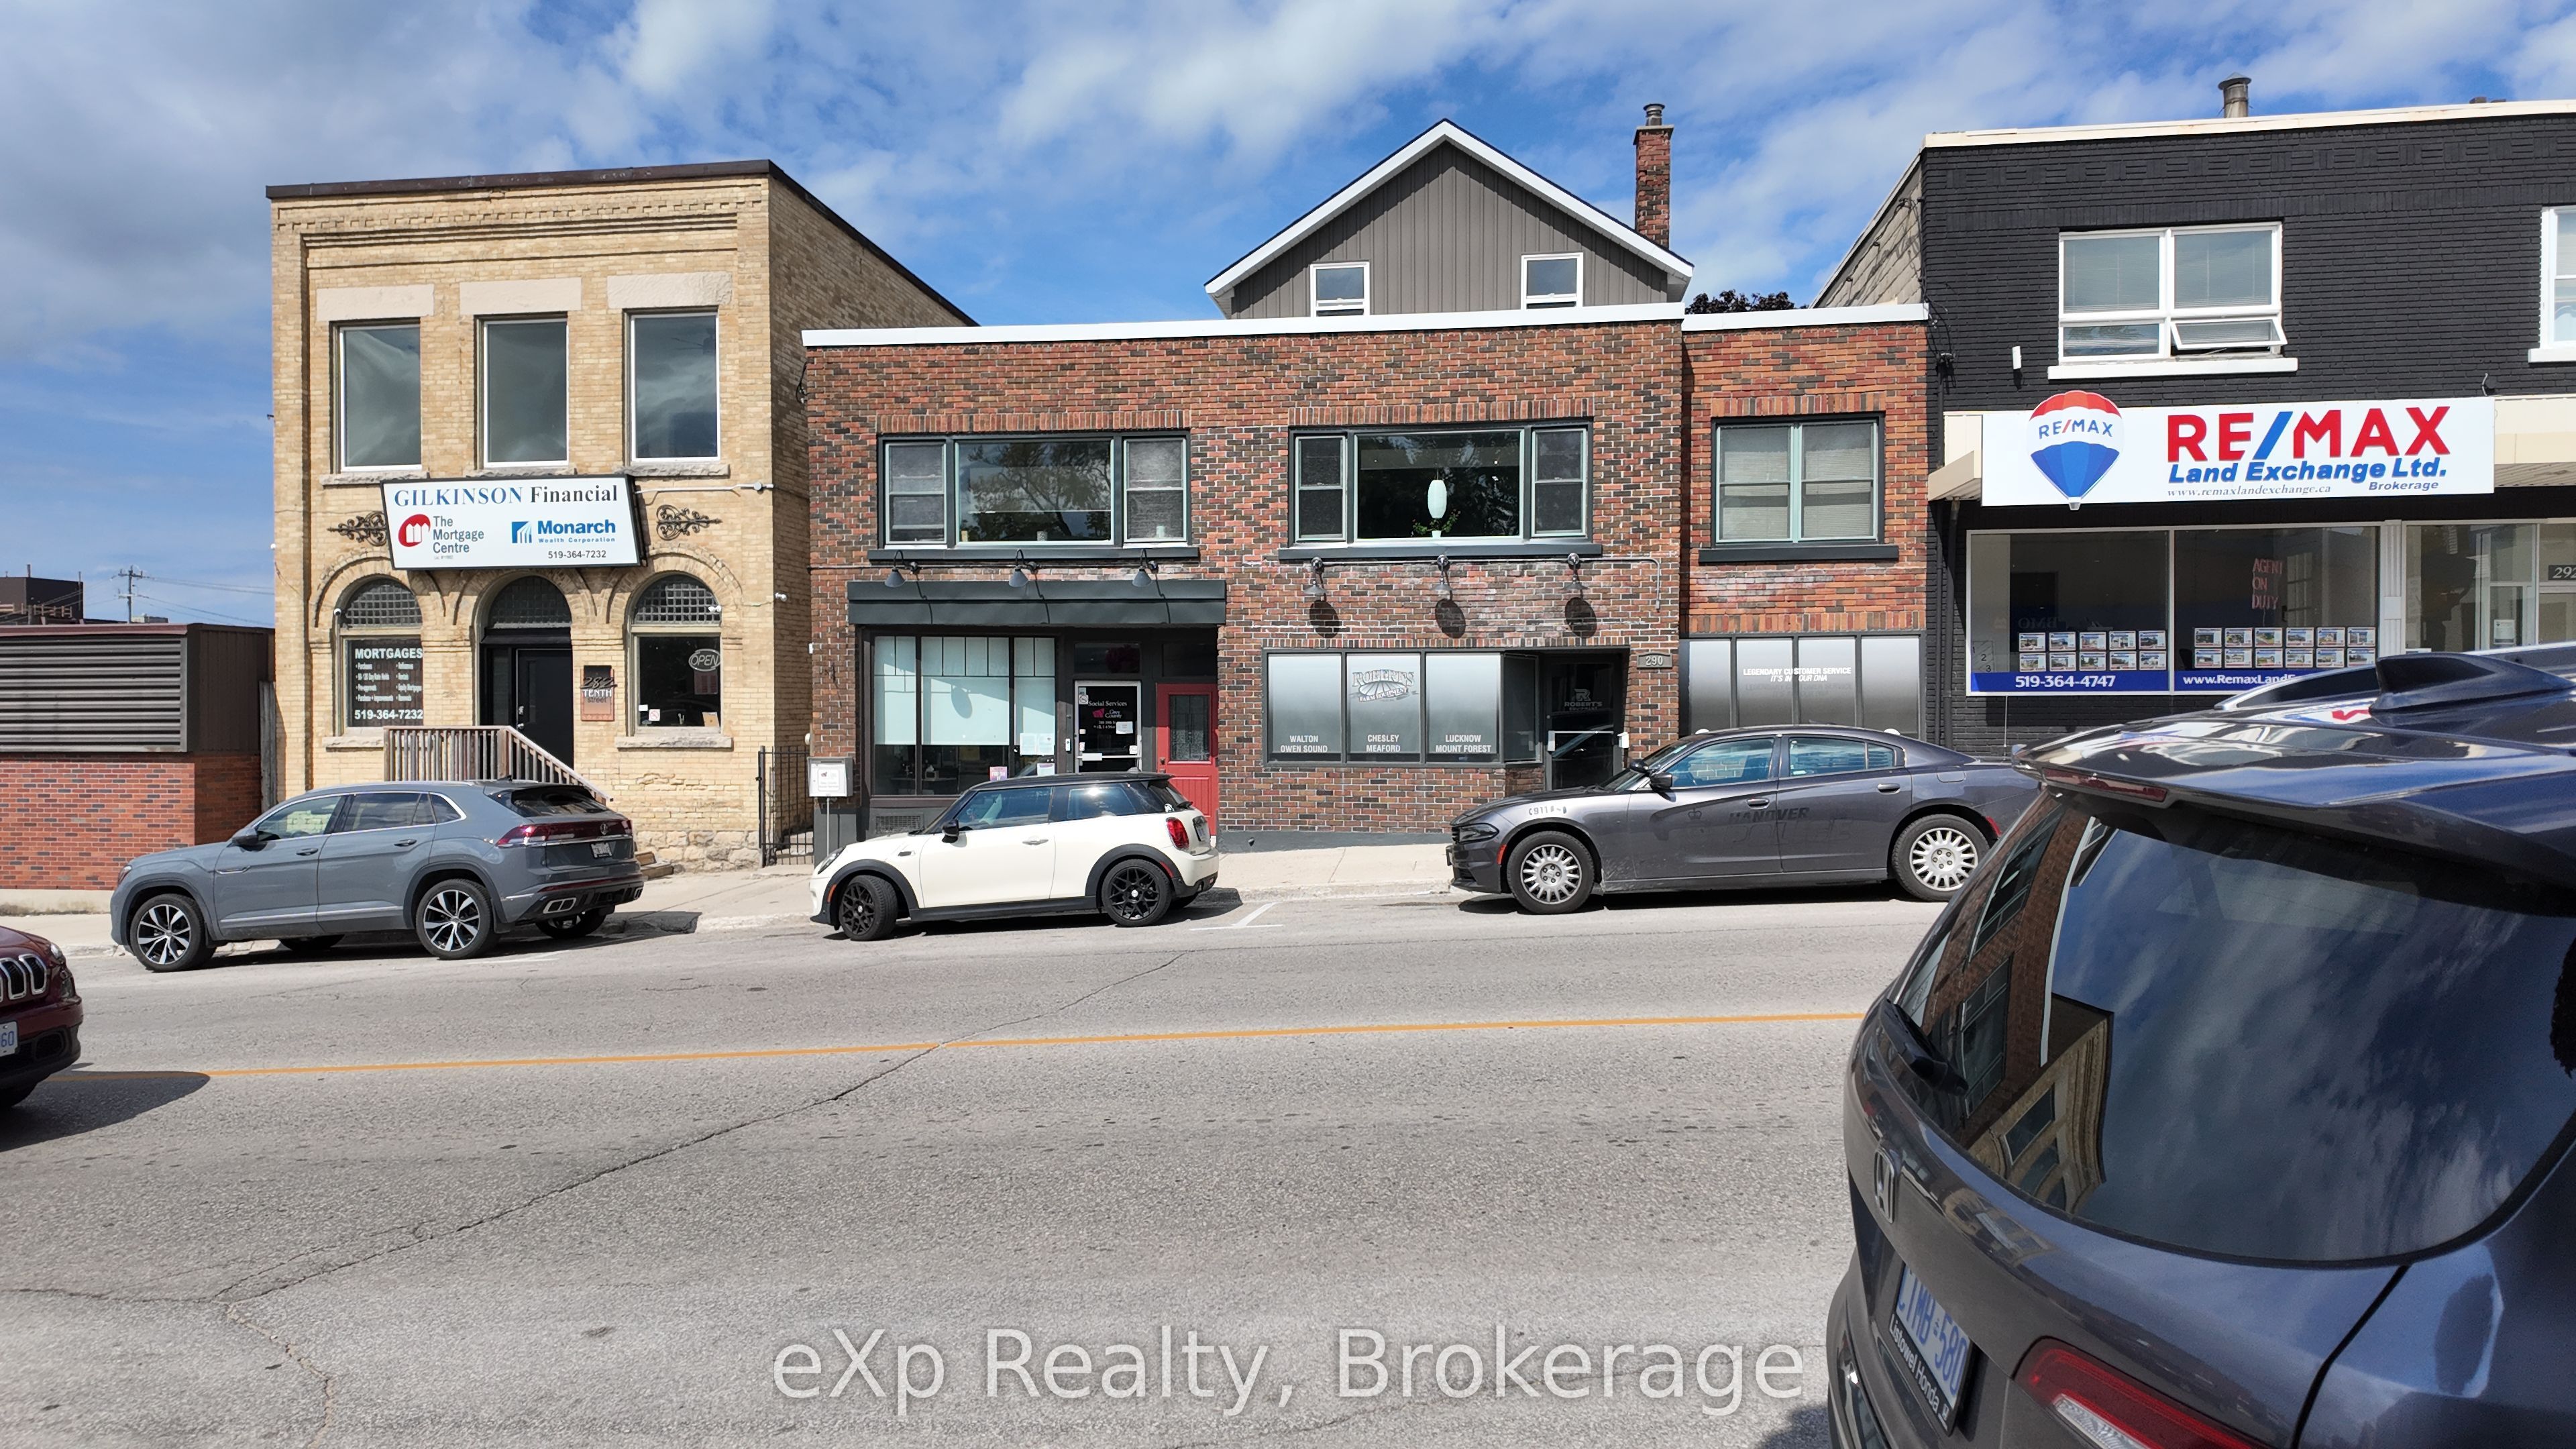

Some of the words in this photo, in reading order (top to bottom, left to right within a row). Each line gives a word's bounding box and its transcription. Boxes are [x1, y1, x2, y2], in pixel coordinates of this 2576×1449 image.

[2039, 419, 2113, 439] RE/MAX
[2167, 407, 2451, 463] RE/MAX
[2168, 462, 2238, 484] Land
[2245, 460, 2386, 484] Exchange
[2392, 457, 2447, 478] Ltd.
[2167, 484, 2331, 496] www.remaxlandexchange.ca
[2369, 481, 2439, 491] Brokerage
[394, 486, 523, 506] GILKINSON
[531, 484, 617, 503] Financial
[433, 516, 453, 527] The
[537, 519, 616, 535] Monarch
[433, 529, 484, 542] Mortgage
[433, 542, 470, 553] Centre
[548, 550, 606, 559] 519-364-7232
[2252, 577, 2267, 590] ON
[2252, 594, 2279, 610] DUTY
[354, 648, 423, 659] MORTGAGES
[1981, 653, 1987, 661] 2
[691, 655, 720, 666] OPEN
[1645, 655, 1664, 666] 290
[580, 676, 617, 690] 282
[2015, 676, 2116, 688] 519-364-4747
[582, 689, 612, 697] TENTH
[354, 709, 423, 719] 519-364-7232
[1289, 735, 1319, 743] WALTON
[1367, 734, 1399, 743] CHESLEY
[1445, 734, 1481, 743] LUCKNOW
[1280, 745, 1301, 753] OWEN
[1303, 745, 1328, 753] SOUND
[1366, 744, 1401, 753] MEAFORD
[1436, 745, 1461, 753] MOUNT
[1463, 745, 1492, 753] FOREST
[1729, 807, 1810, 822] HANOVER
[1935, 1313, 1968, 1396] 580
[1889, 1313, 1918, 1373] Listowel
[1915, 1361, 1940, 1413] Honda
